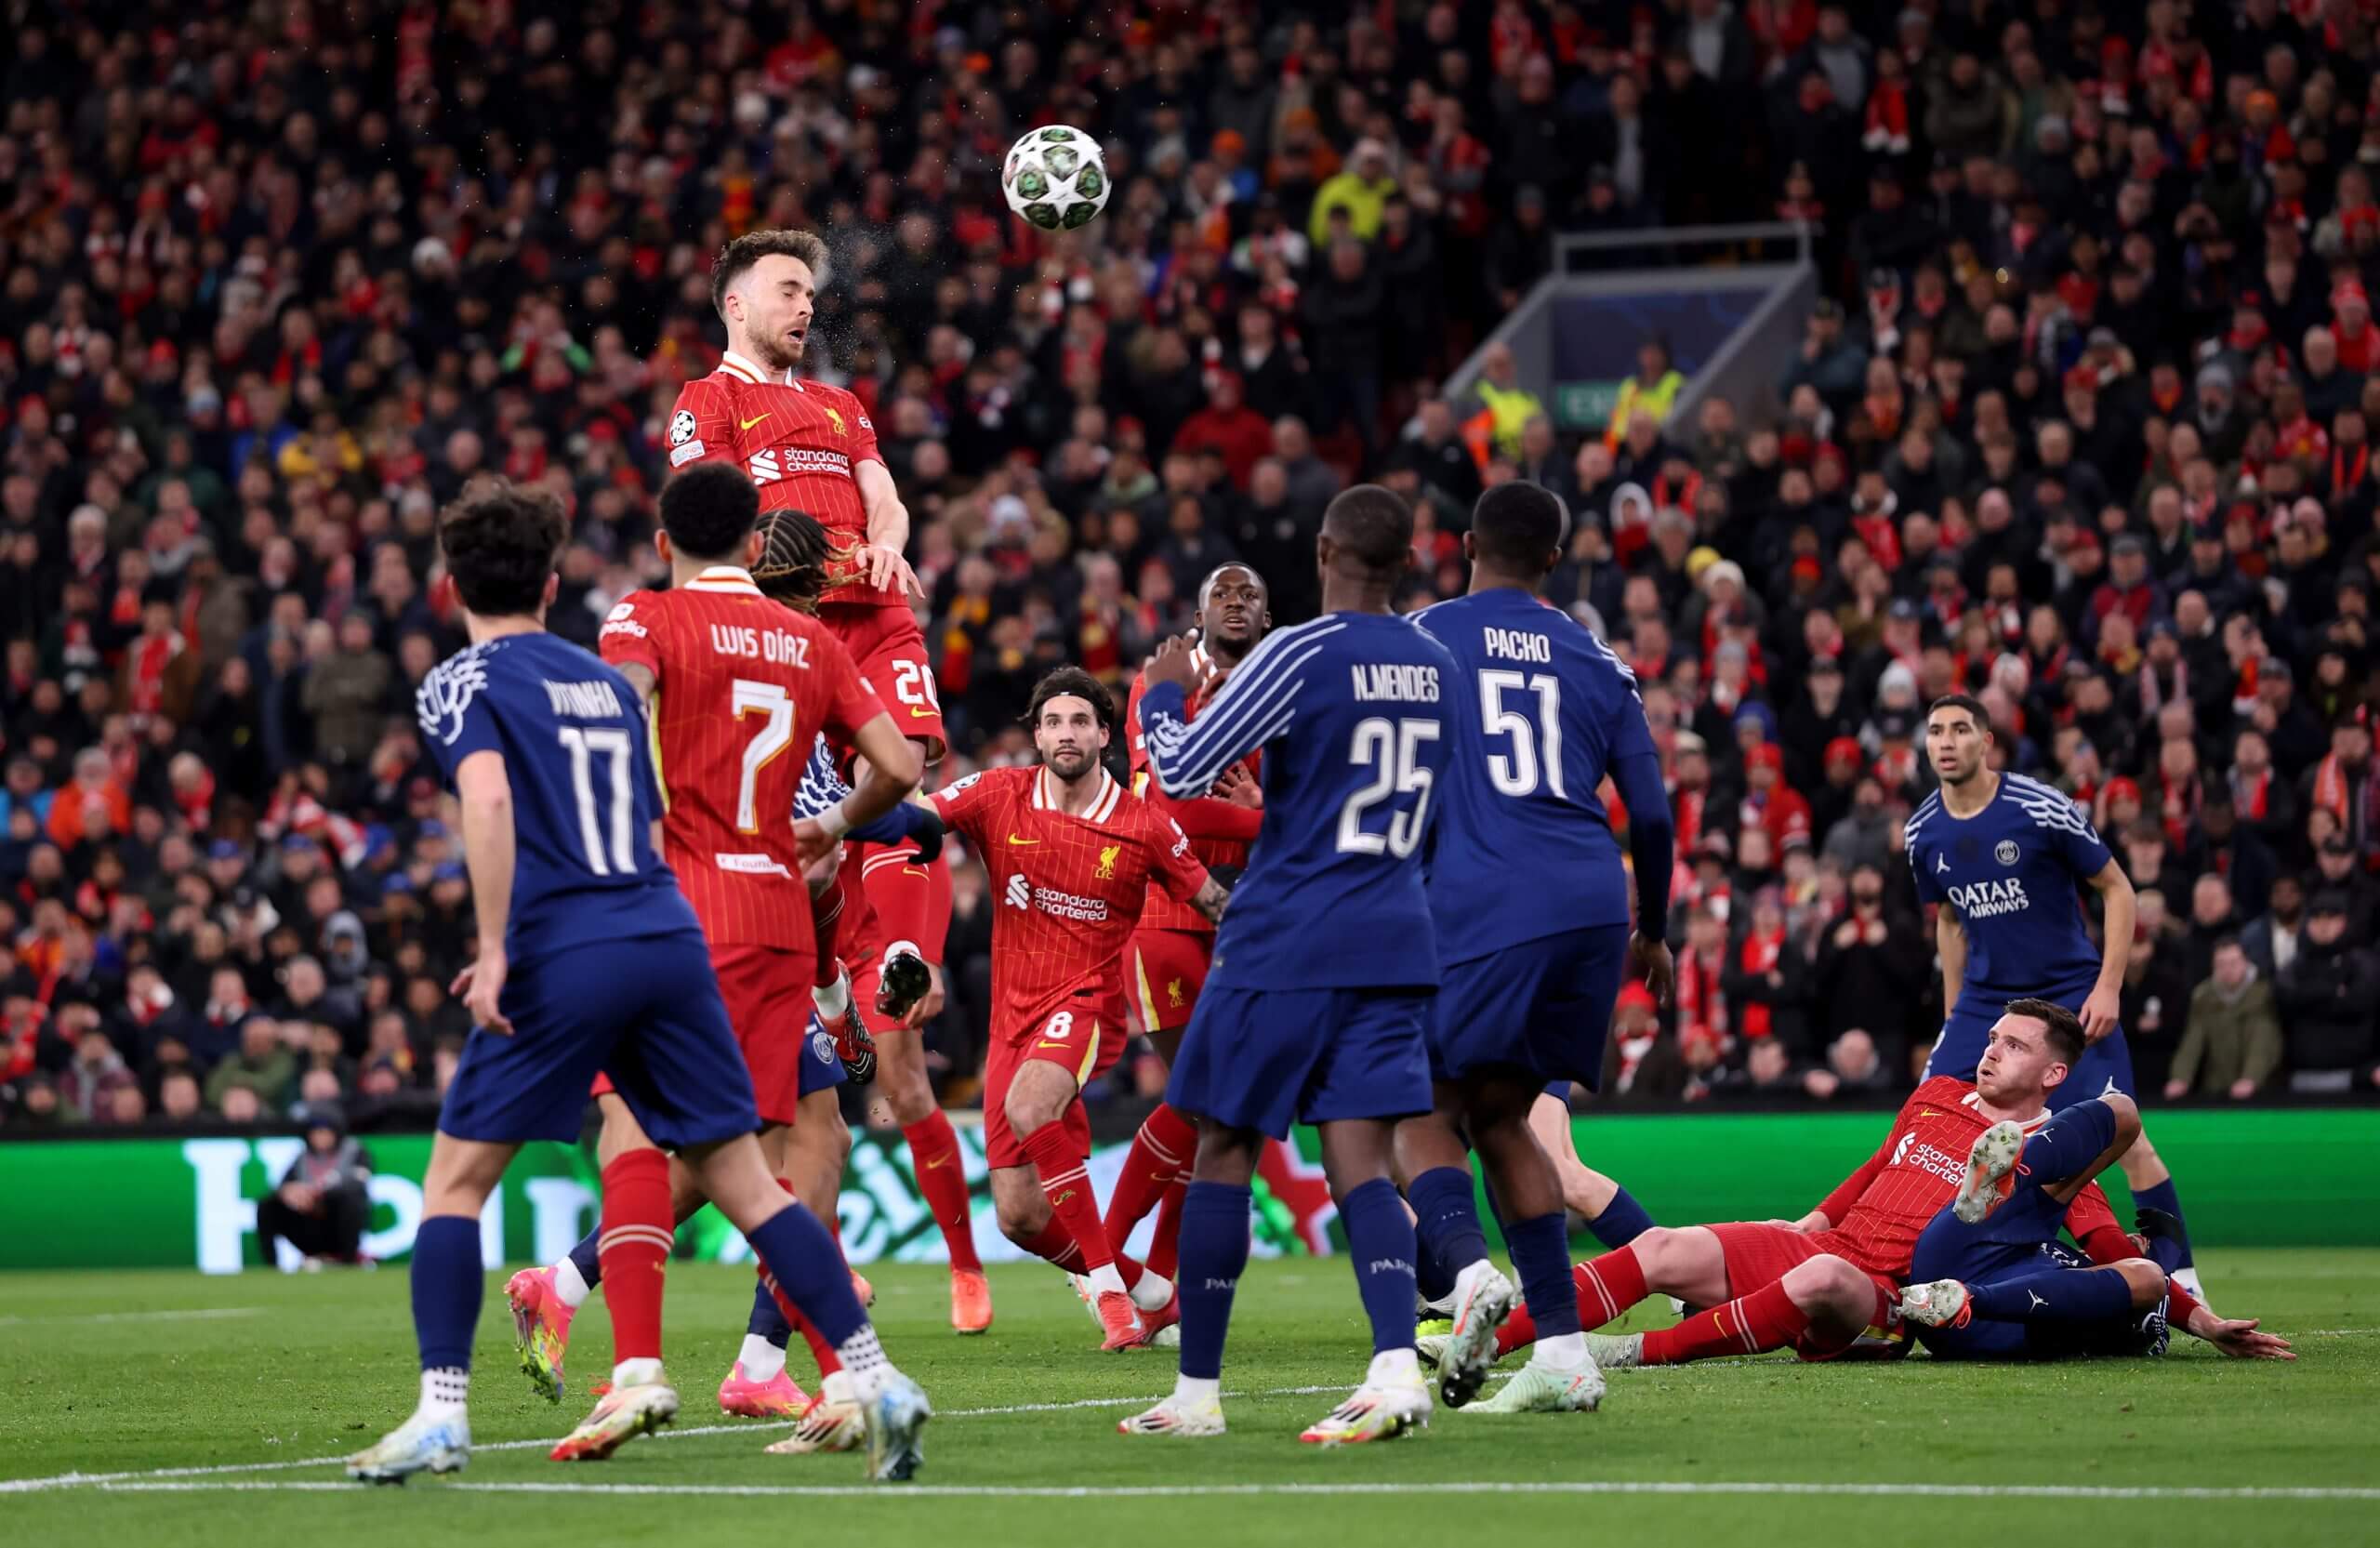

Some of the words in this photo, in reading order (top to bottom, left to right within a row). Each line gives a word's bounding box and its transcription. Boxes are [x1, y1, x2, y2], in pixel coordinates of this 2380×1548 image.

[710, 623, 760, 659] LUIS
[761, 627, 811, 669] DÍAZ
[1484, 627, 1552, 664] PACHO
[1351, 664, 1440, 703] N.MENDES
[1478, 668, 1568, 800] 51
[732, 678, 796, 834] 7
[559, 726, 638, 875] 17
[1335, 717, 1440, 859] 25
[1035, 886, 1107, 910] standard
[1035, 899, 1108, 921] chartered
[1948, 877, 2026, 910] QATAR
[1969, 894, 2030, 920] AIRWAYS
[1045, 1011, 1074, 1039] 8
[1909, 1154, 1964, 1187] charter
[1916, 1143, 1967, 1176] standa
